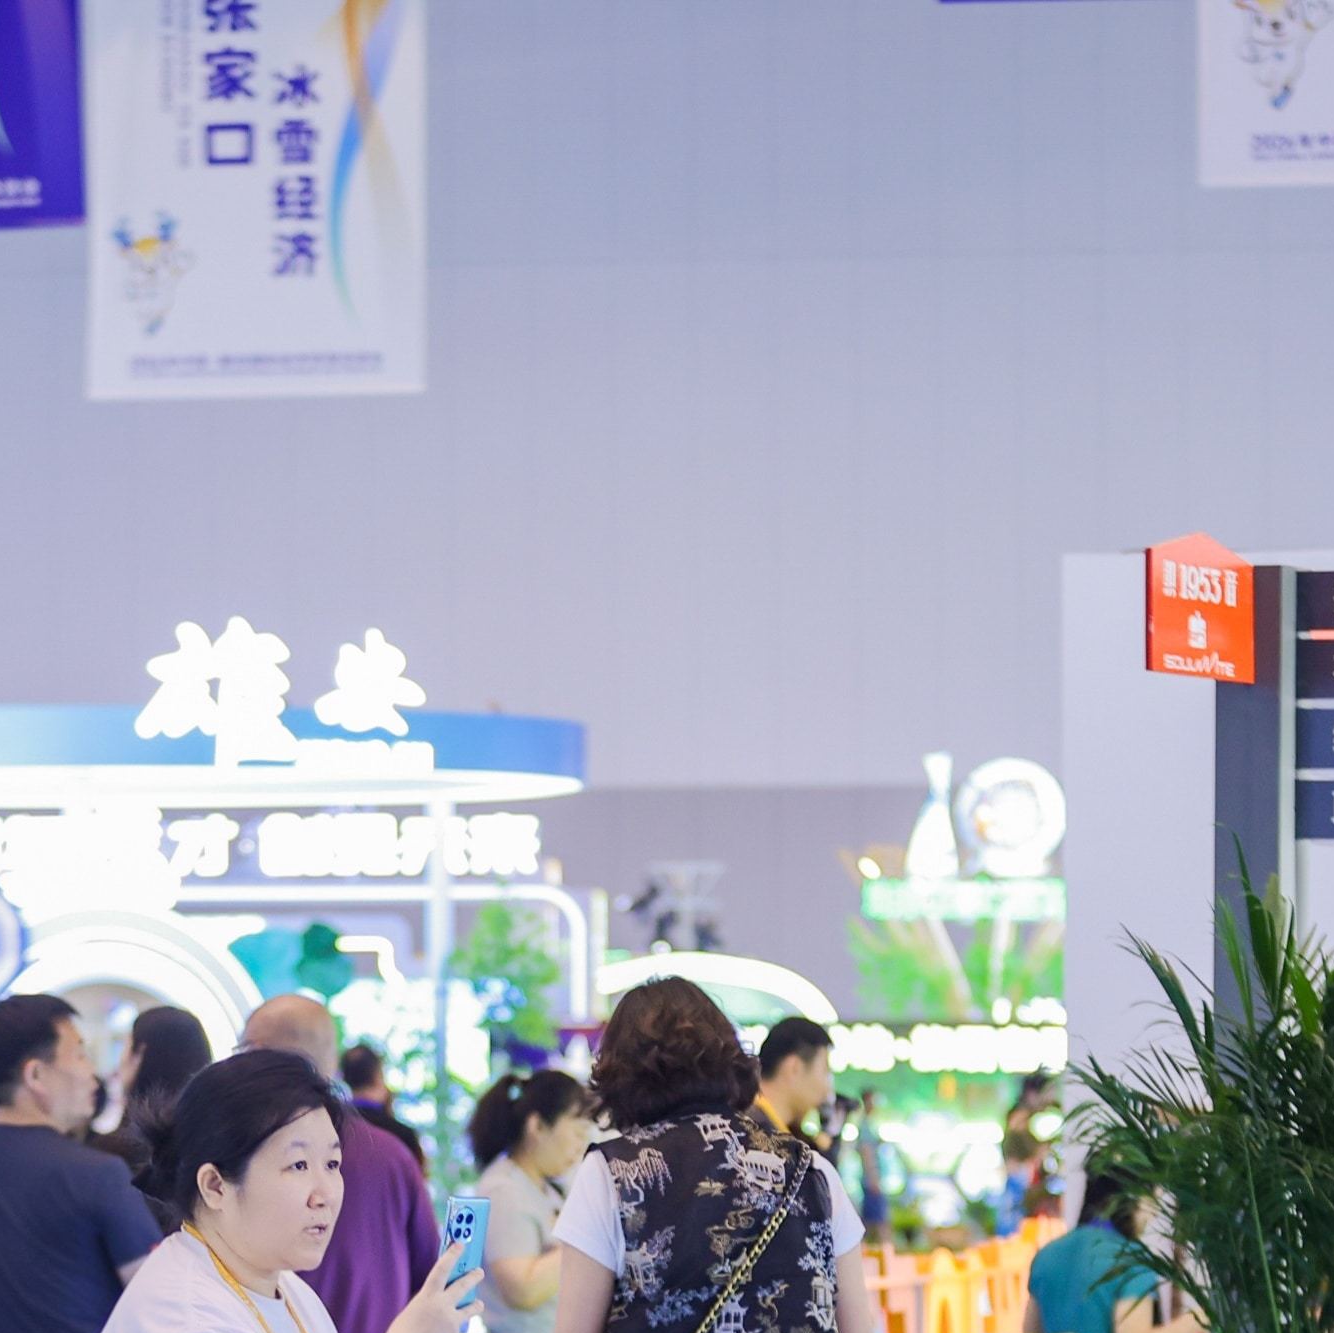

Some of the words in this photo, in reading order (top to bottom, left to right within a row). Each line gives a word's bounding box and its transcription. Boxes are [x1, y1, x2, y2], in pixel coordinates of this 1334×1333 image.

[203, 0, 257, 166] 张家口
[272, 65, 321, 278] 冰雪经济
